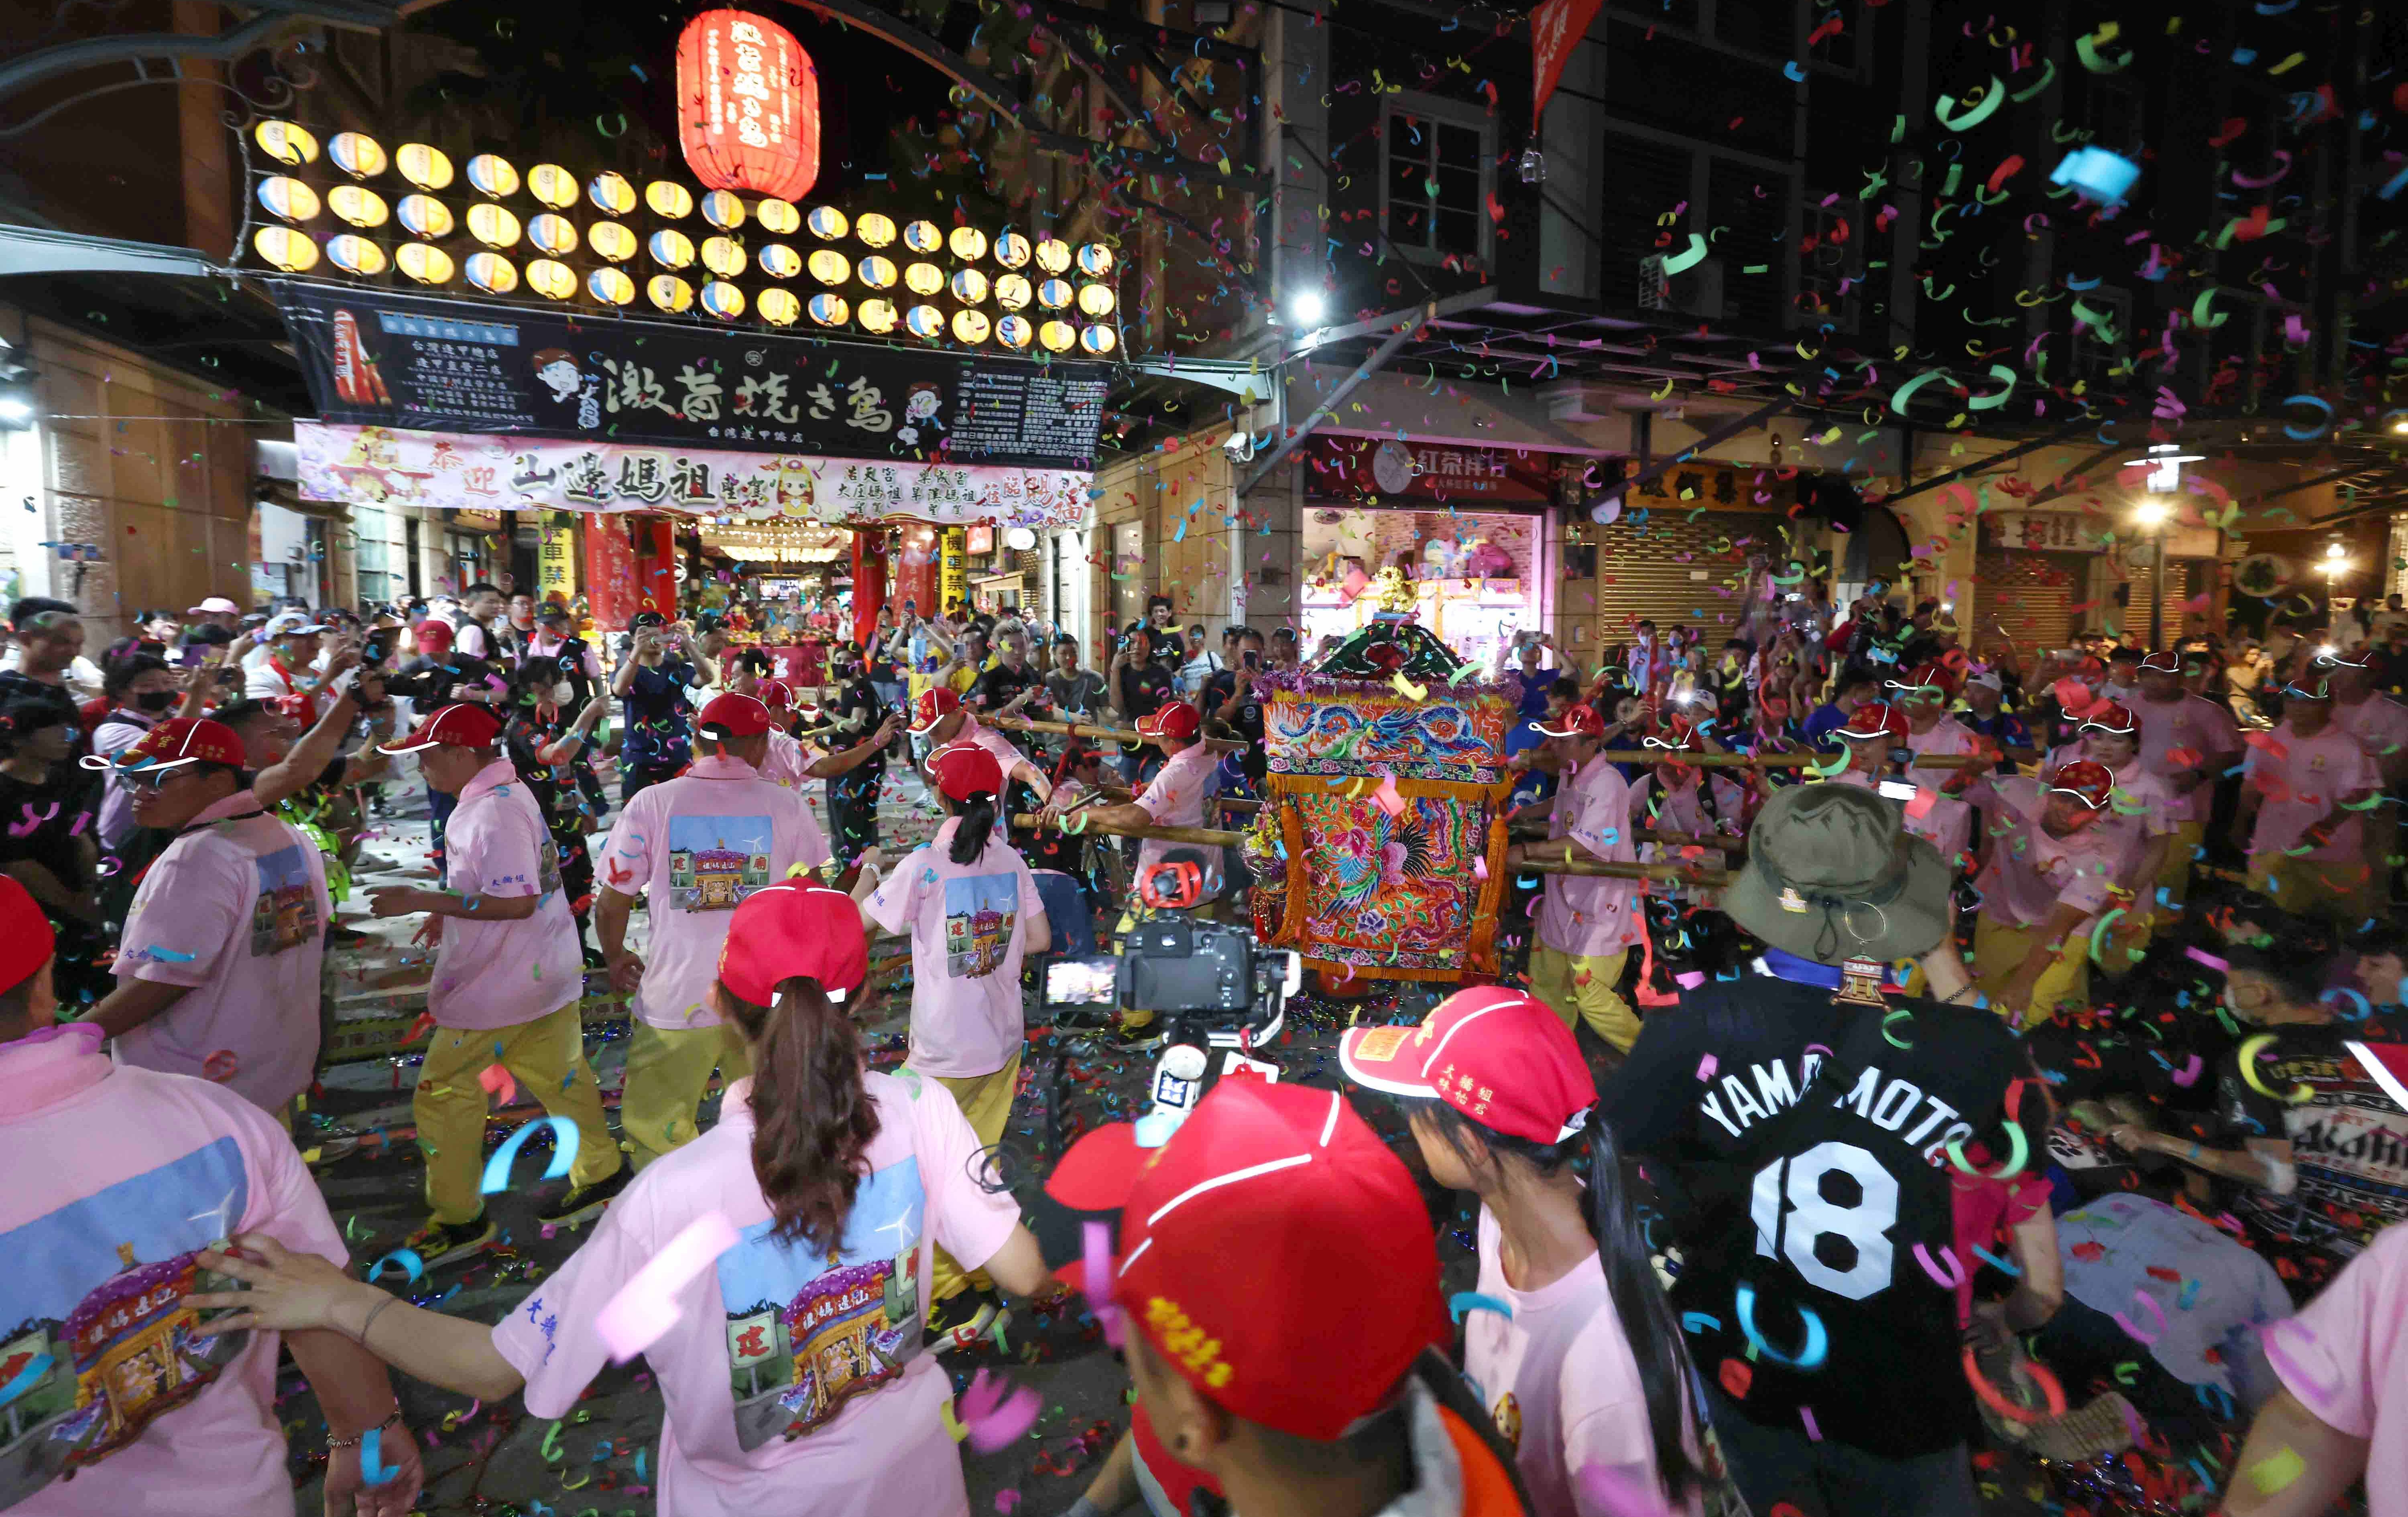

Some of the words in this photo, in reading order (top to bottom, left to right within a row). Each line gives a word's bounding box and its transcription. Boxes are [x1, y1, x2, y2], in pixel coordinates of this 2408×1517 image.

[604, 359, 892, 433] 激旨焼き鳥
[430, 441, 496, 496] 恭迎
[511, 452, 718, 502] 山邊媽祖
[1750, 1141, 1900, 1301] 18
